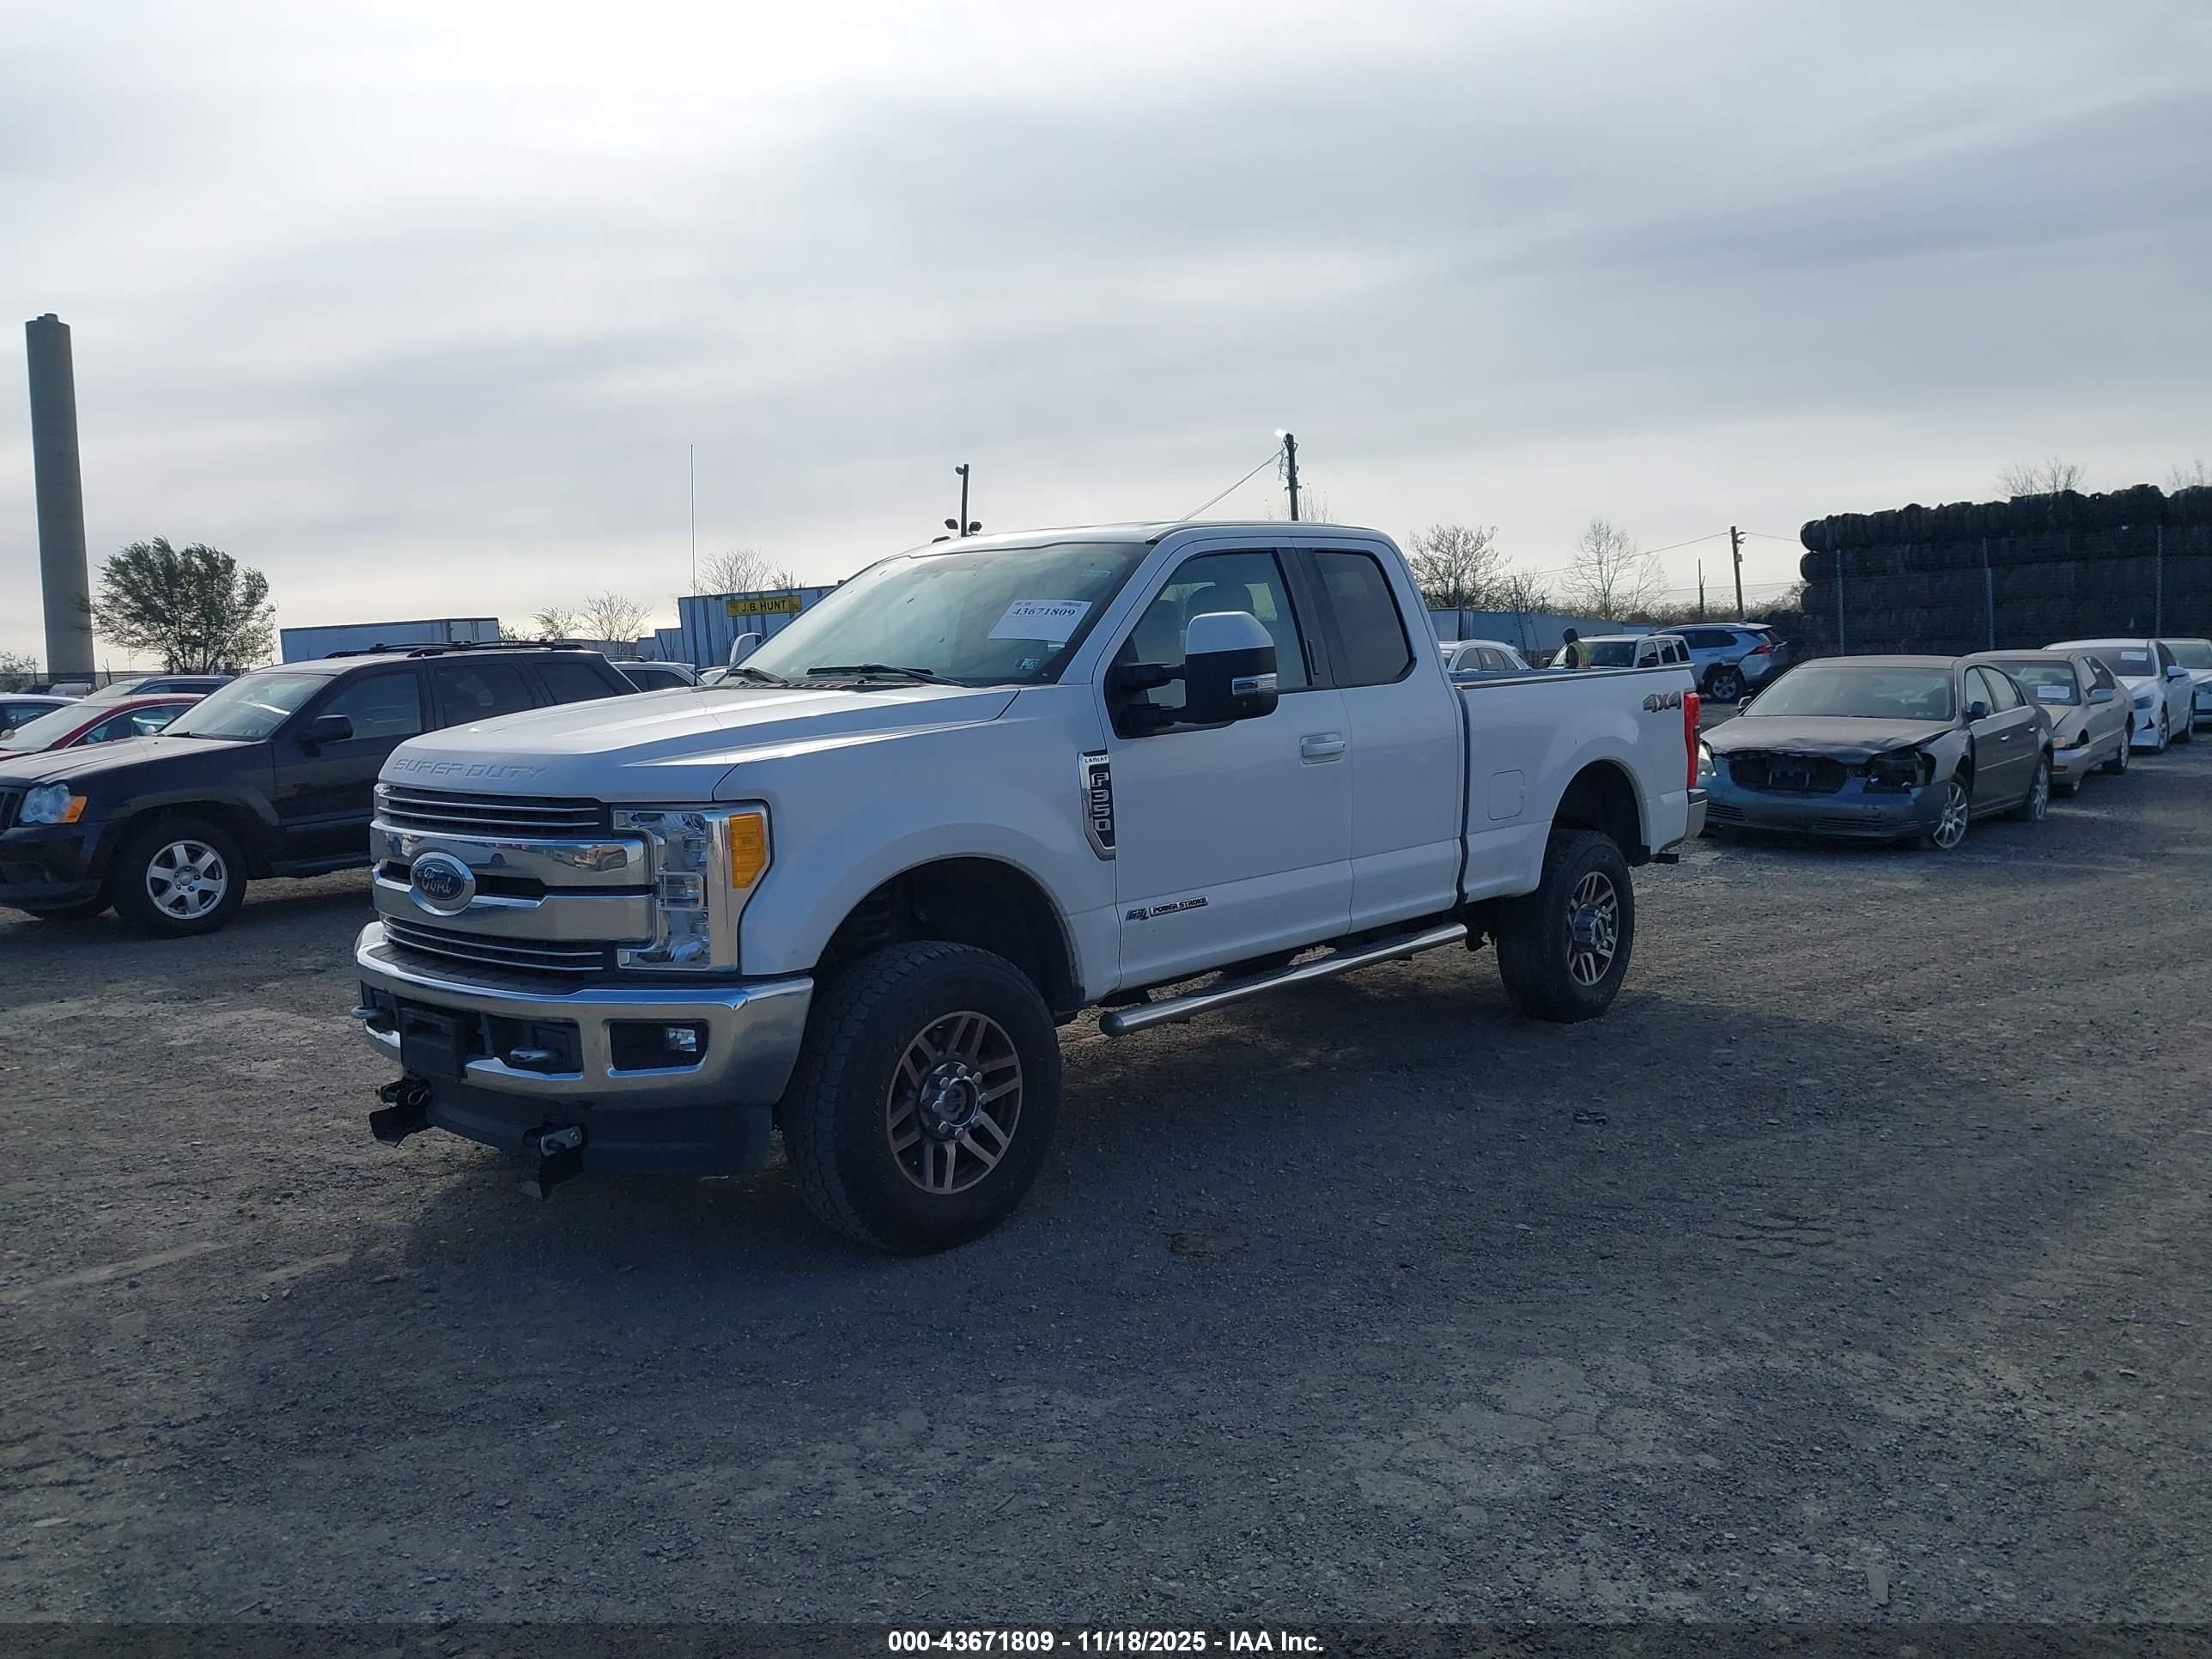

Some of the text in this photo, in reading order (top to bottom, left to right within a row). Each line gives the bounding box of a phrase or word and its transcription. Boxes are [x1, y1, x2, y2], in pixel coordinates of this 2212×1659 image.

[741, 600, 787, 612] J.B. HUNT
[1012, 607, 1076, 617] 43671809
[393, 758, 549, 780] SUPER DUTY
[421, 866, 453, 894] Ford
[1178, 896, 1207, 908] STROKE
